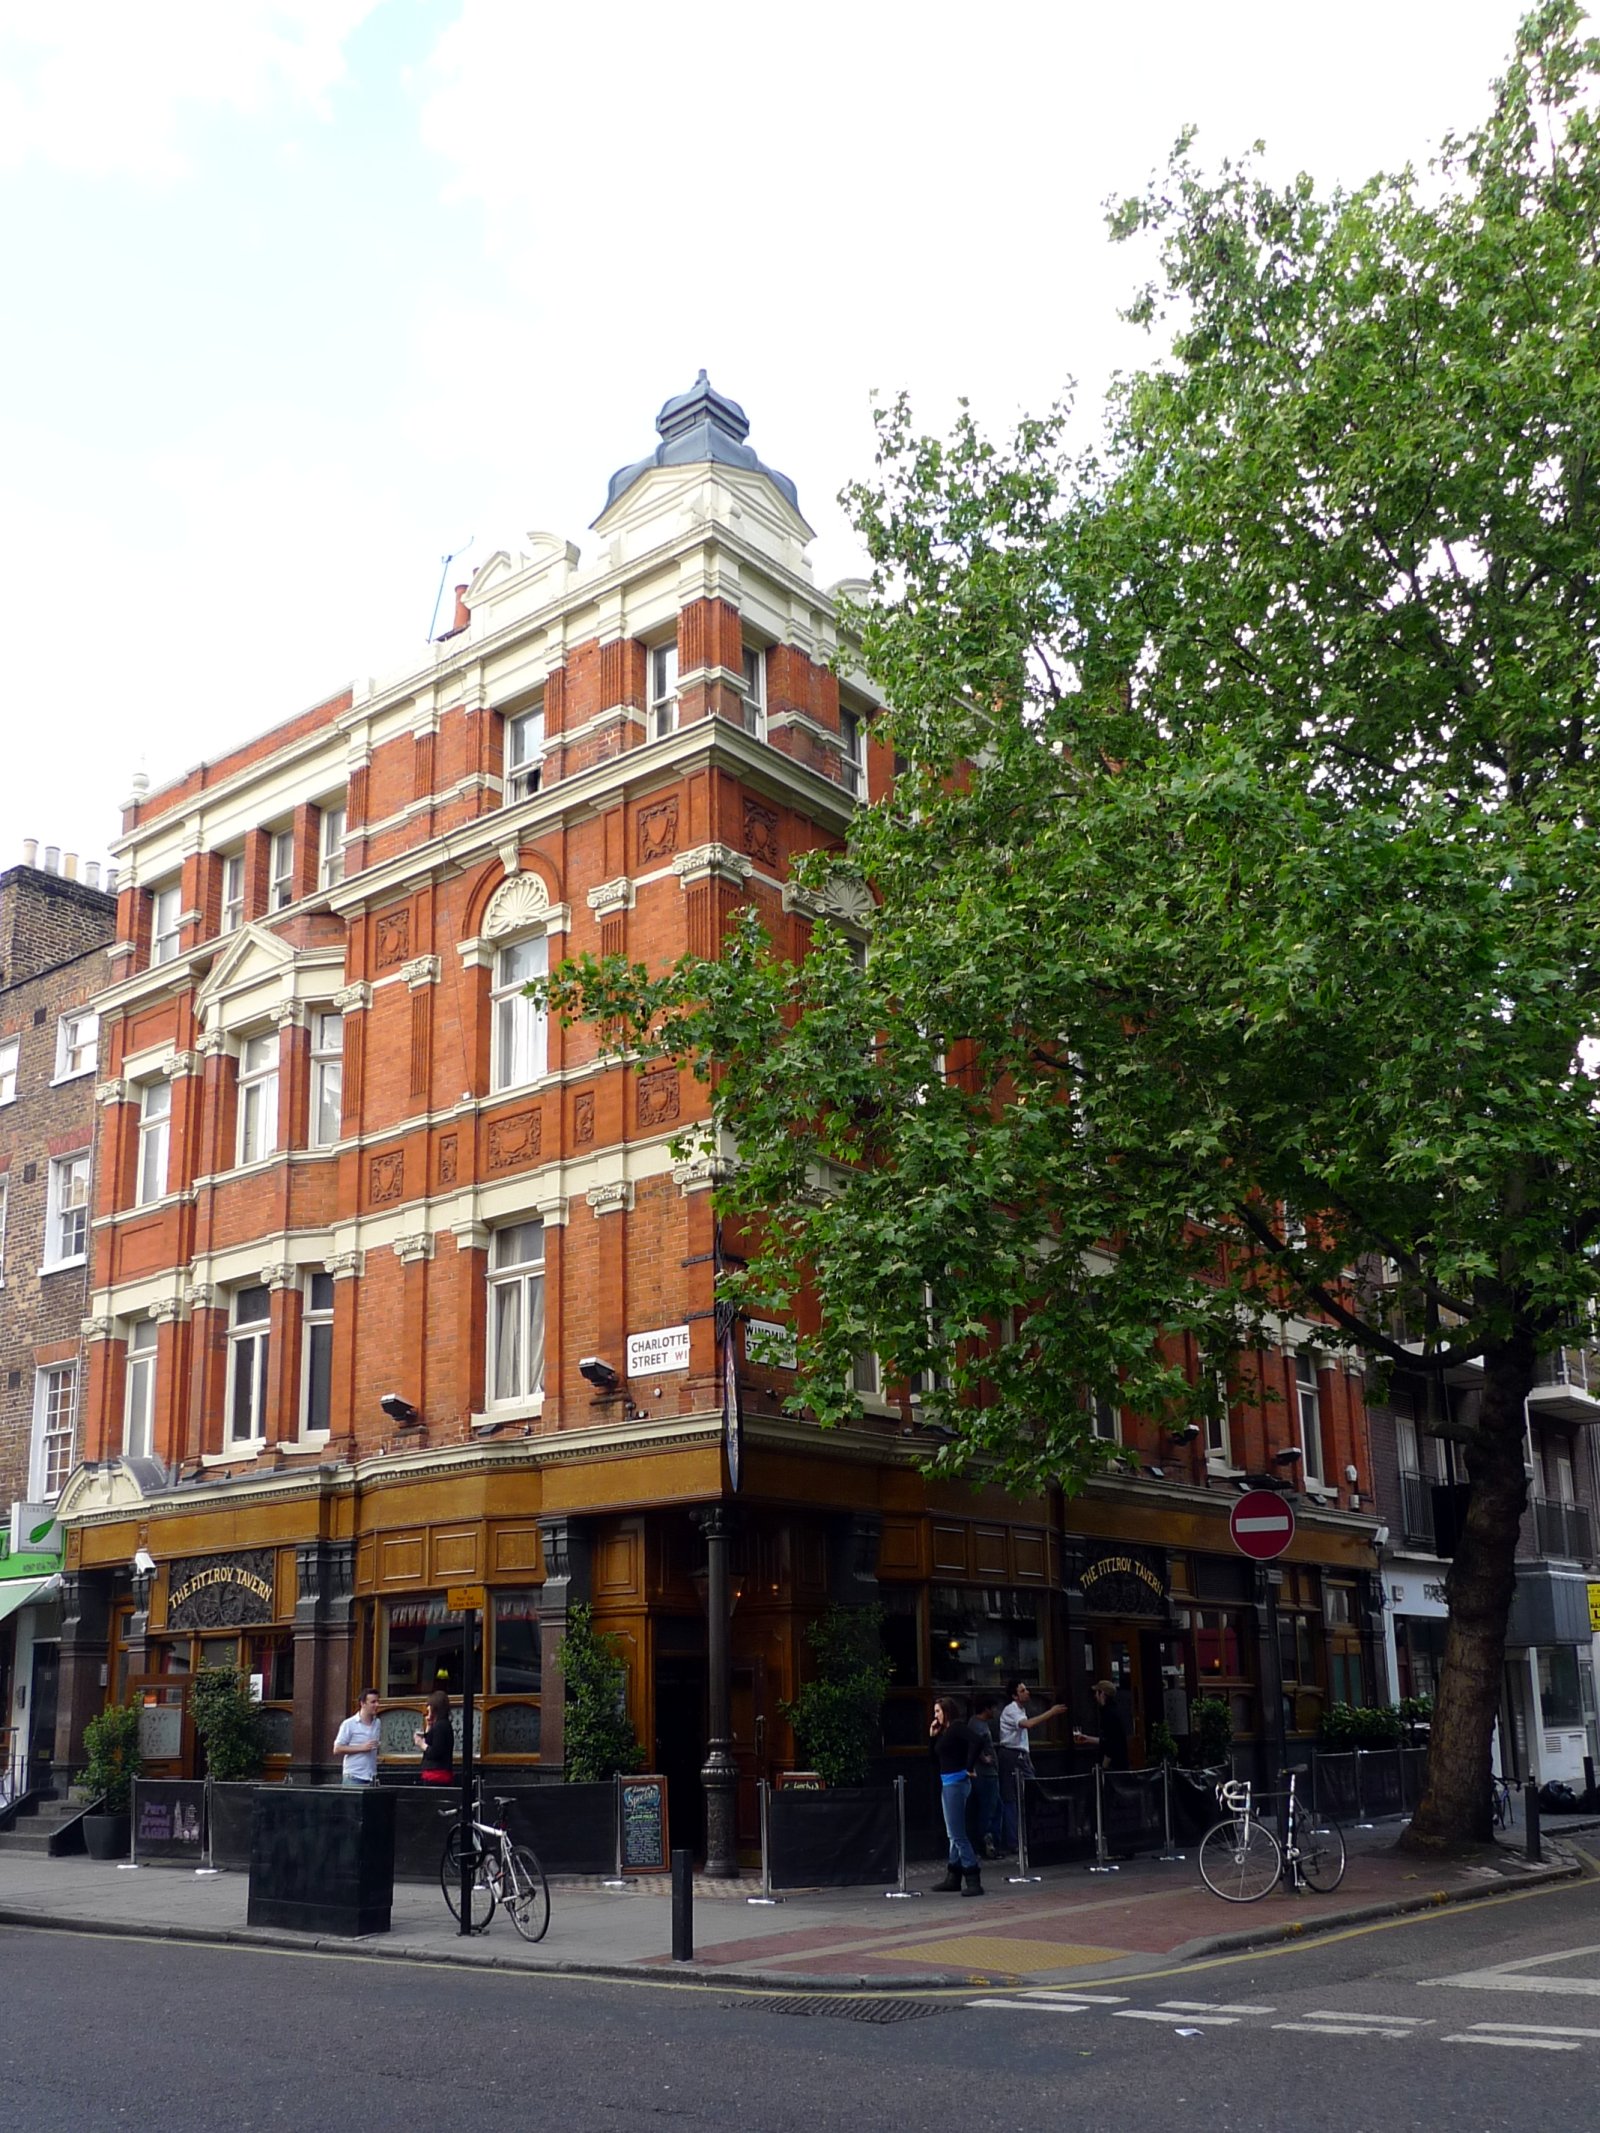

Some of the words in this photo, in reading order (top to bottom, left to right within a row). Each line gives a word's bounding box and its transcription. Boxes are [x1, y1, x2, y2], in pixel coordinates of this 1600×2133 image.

[631, 1333, 688, 1353] CHARLOTTE
[632, 1352, 668, 1369] STREET
[169, 1582, 191, 1609] THE
[191, 1566, 234, 1592] FITZROY
[236, 1567, 272, 1603] TAVERN
[1080, 1565, 1098, 1590] THE
[1098, 1557, 1131, 1576] FITZROY
[1135, 1560, 1163, 1597] TAVERN
